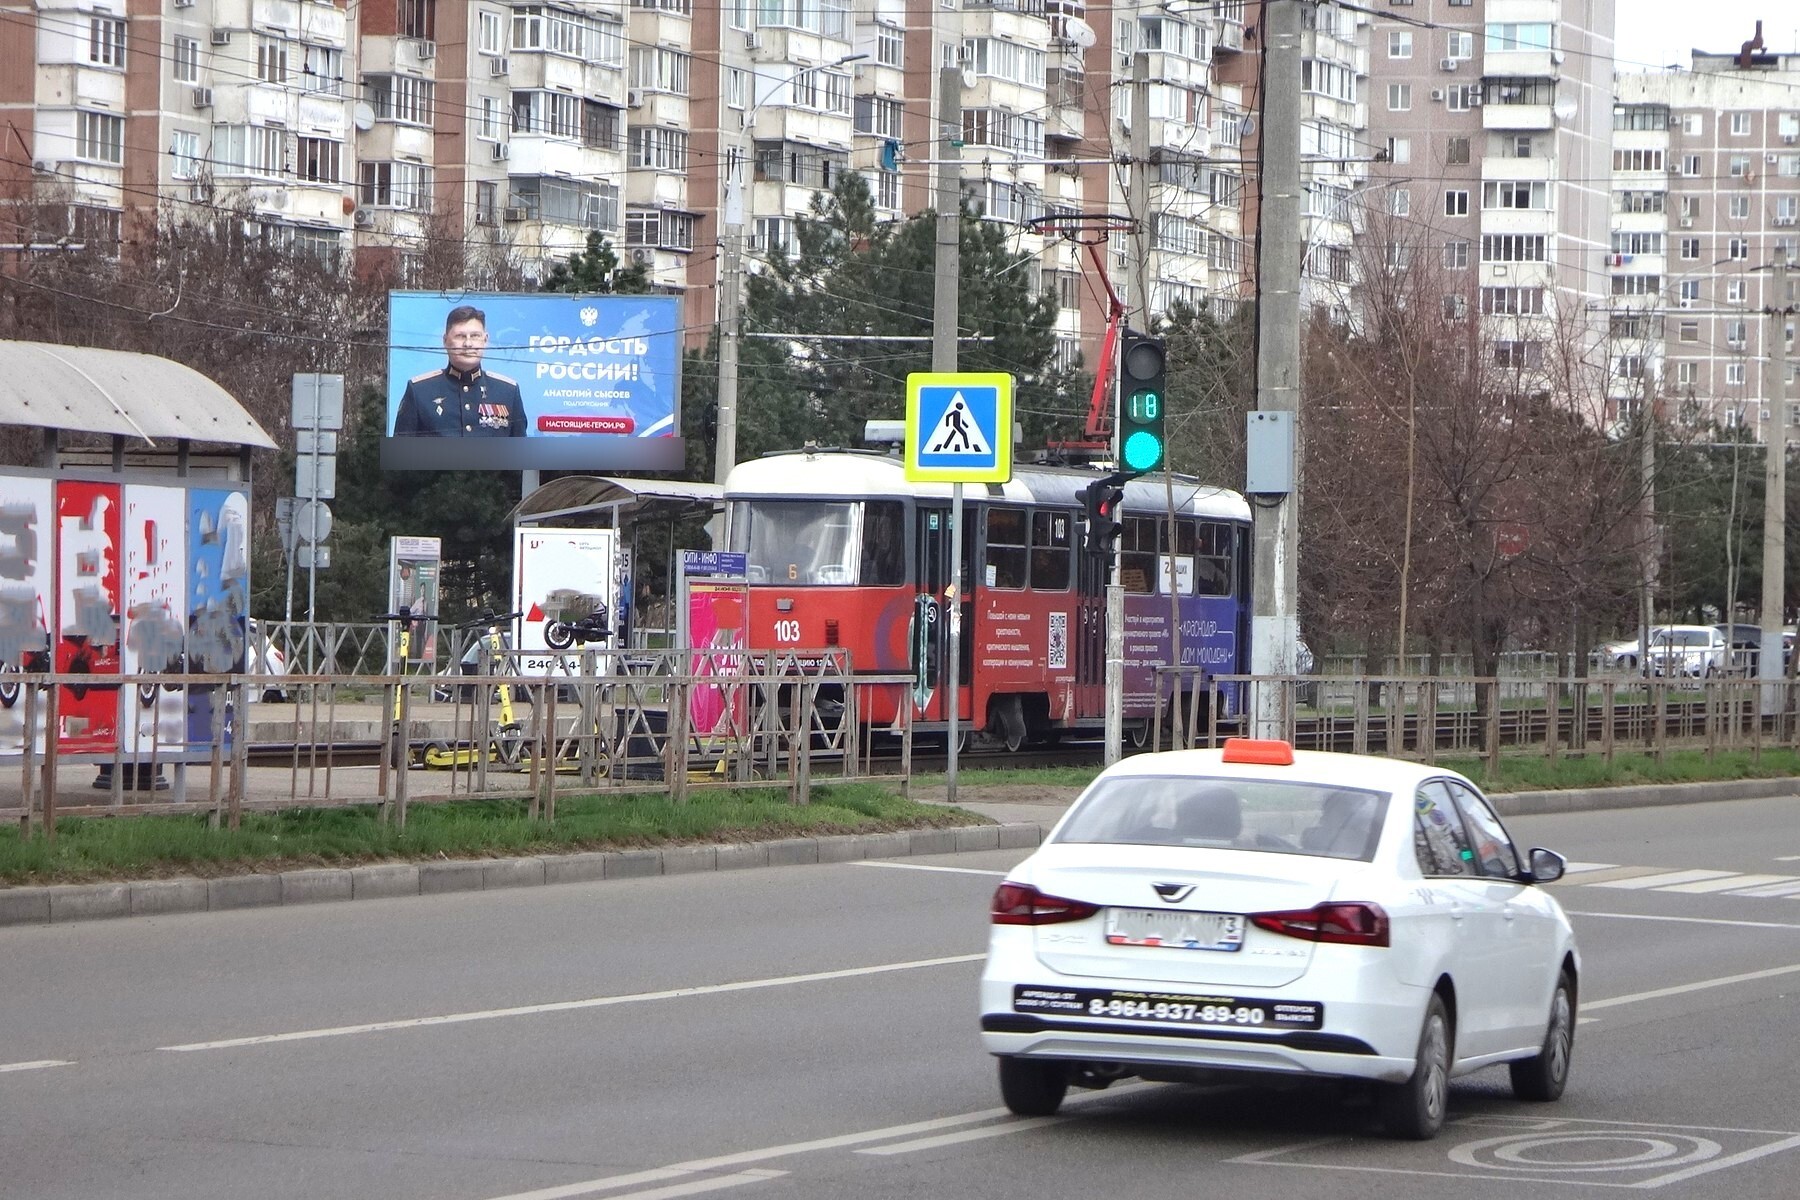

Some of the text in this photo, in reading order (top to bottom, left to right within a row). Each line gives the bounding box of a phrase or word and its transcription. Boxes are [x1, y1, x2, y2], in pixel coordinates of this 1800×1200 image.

[528, 335, 648, 356] ГОРДОСТЬ
[536, 361, 639, 382] РОССИИ!
[543, 388, 630, 399] АНАТОЛИЙ СЫСОЕВ
[1133, 394, 1157, 418] 18
[545, 420, 626, 430] НАСТОЯЩИЕ-ГЕРОИ.РФ
[1055, 518, 1065, 539] 103
[774, 620, 800, 641] 103
[1088, 998, 1264, 1024] 8-964-937-89-90
